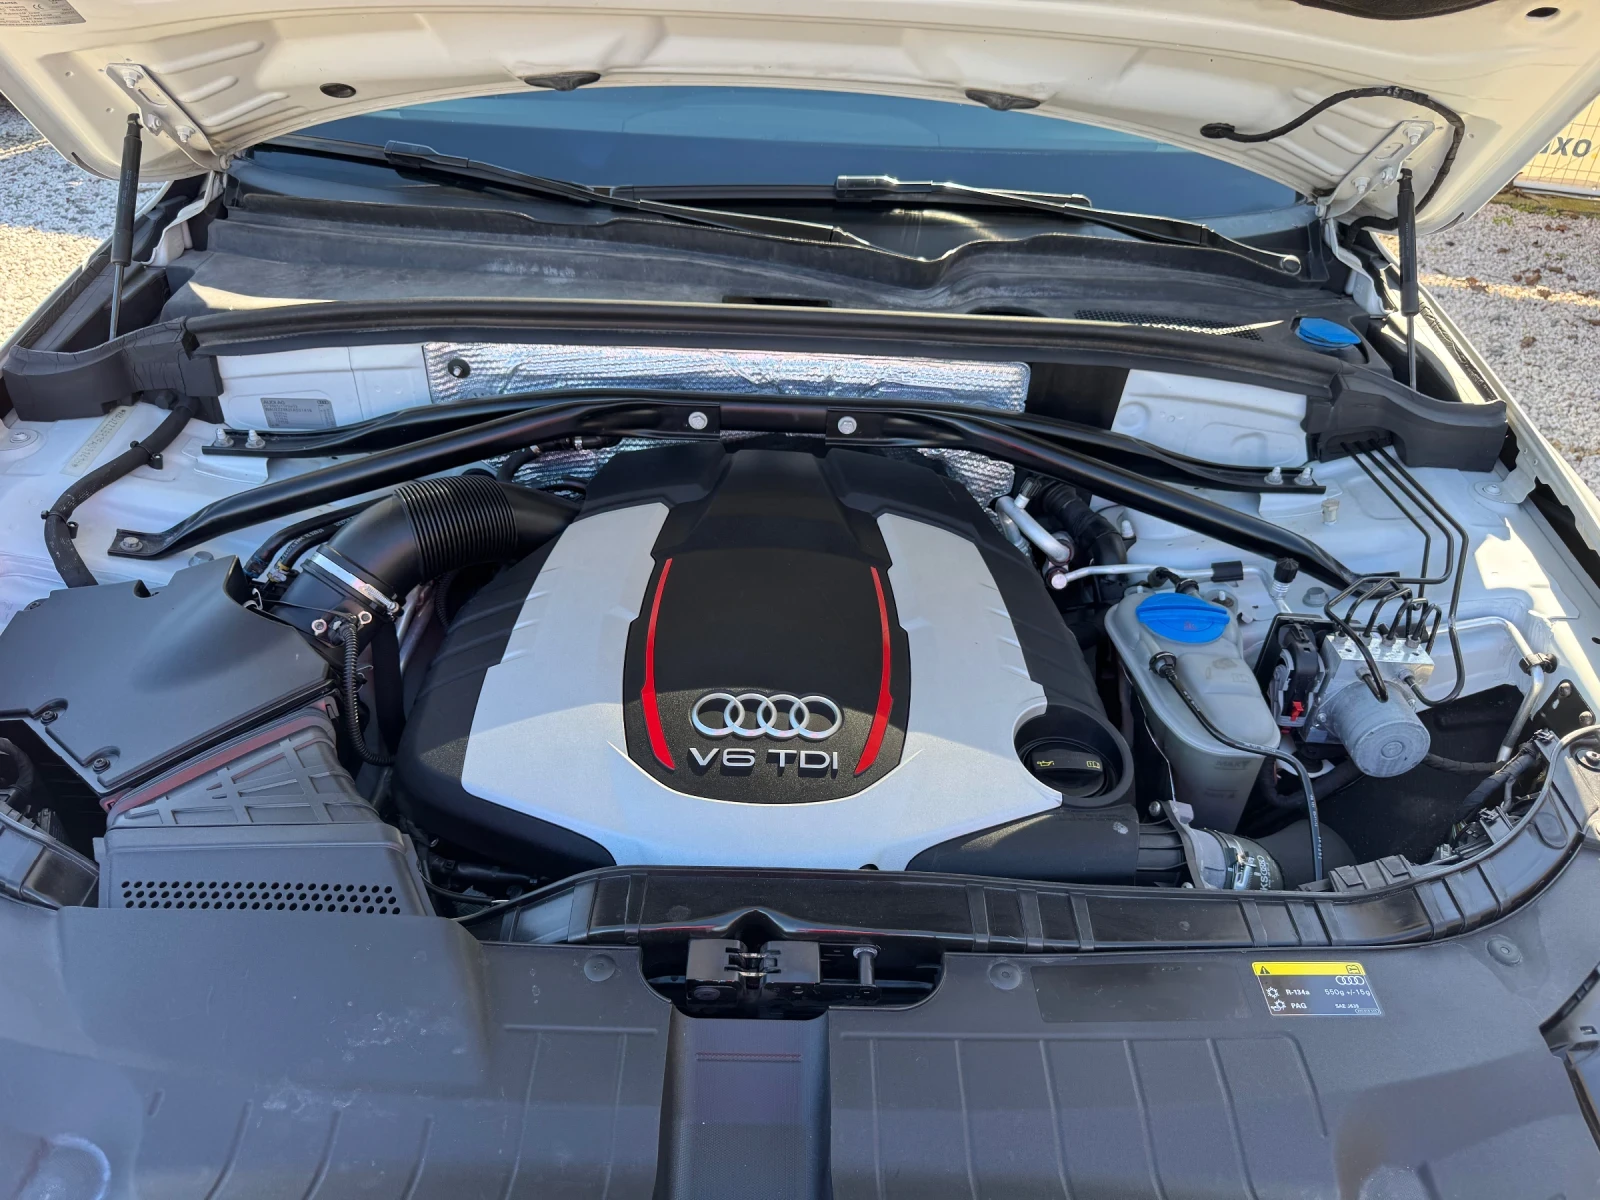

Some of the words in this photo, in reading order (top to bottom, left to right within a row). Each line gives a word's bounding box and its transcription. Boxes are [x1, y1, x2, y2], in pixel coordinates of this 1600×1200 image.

[1540, 136, 1592, 158] XO
[689, 747, 756, 767] V6
[768, 749, 838, 770] TDI
[1285, 988, 1310, 996] R-134a
[1324, 988, 1345, 996] 550g
